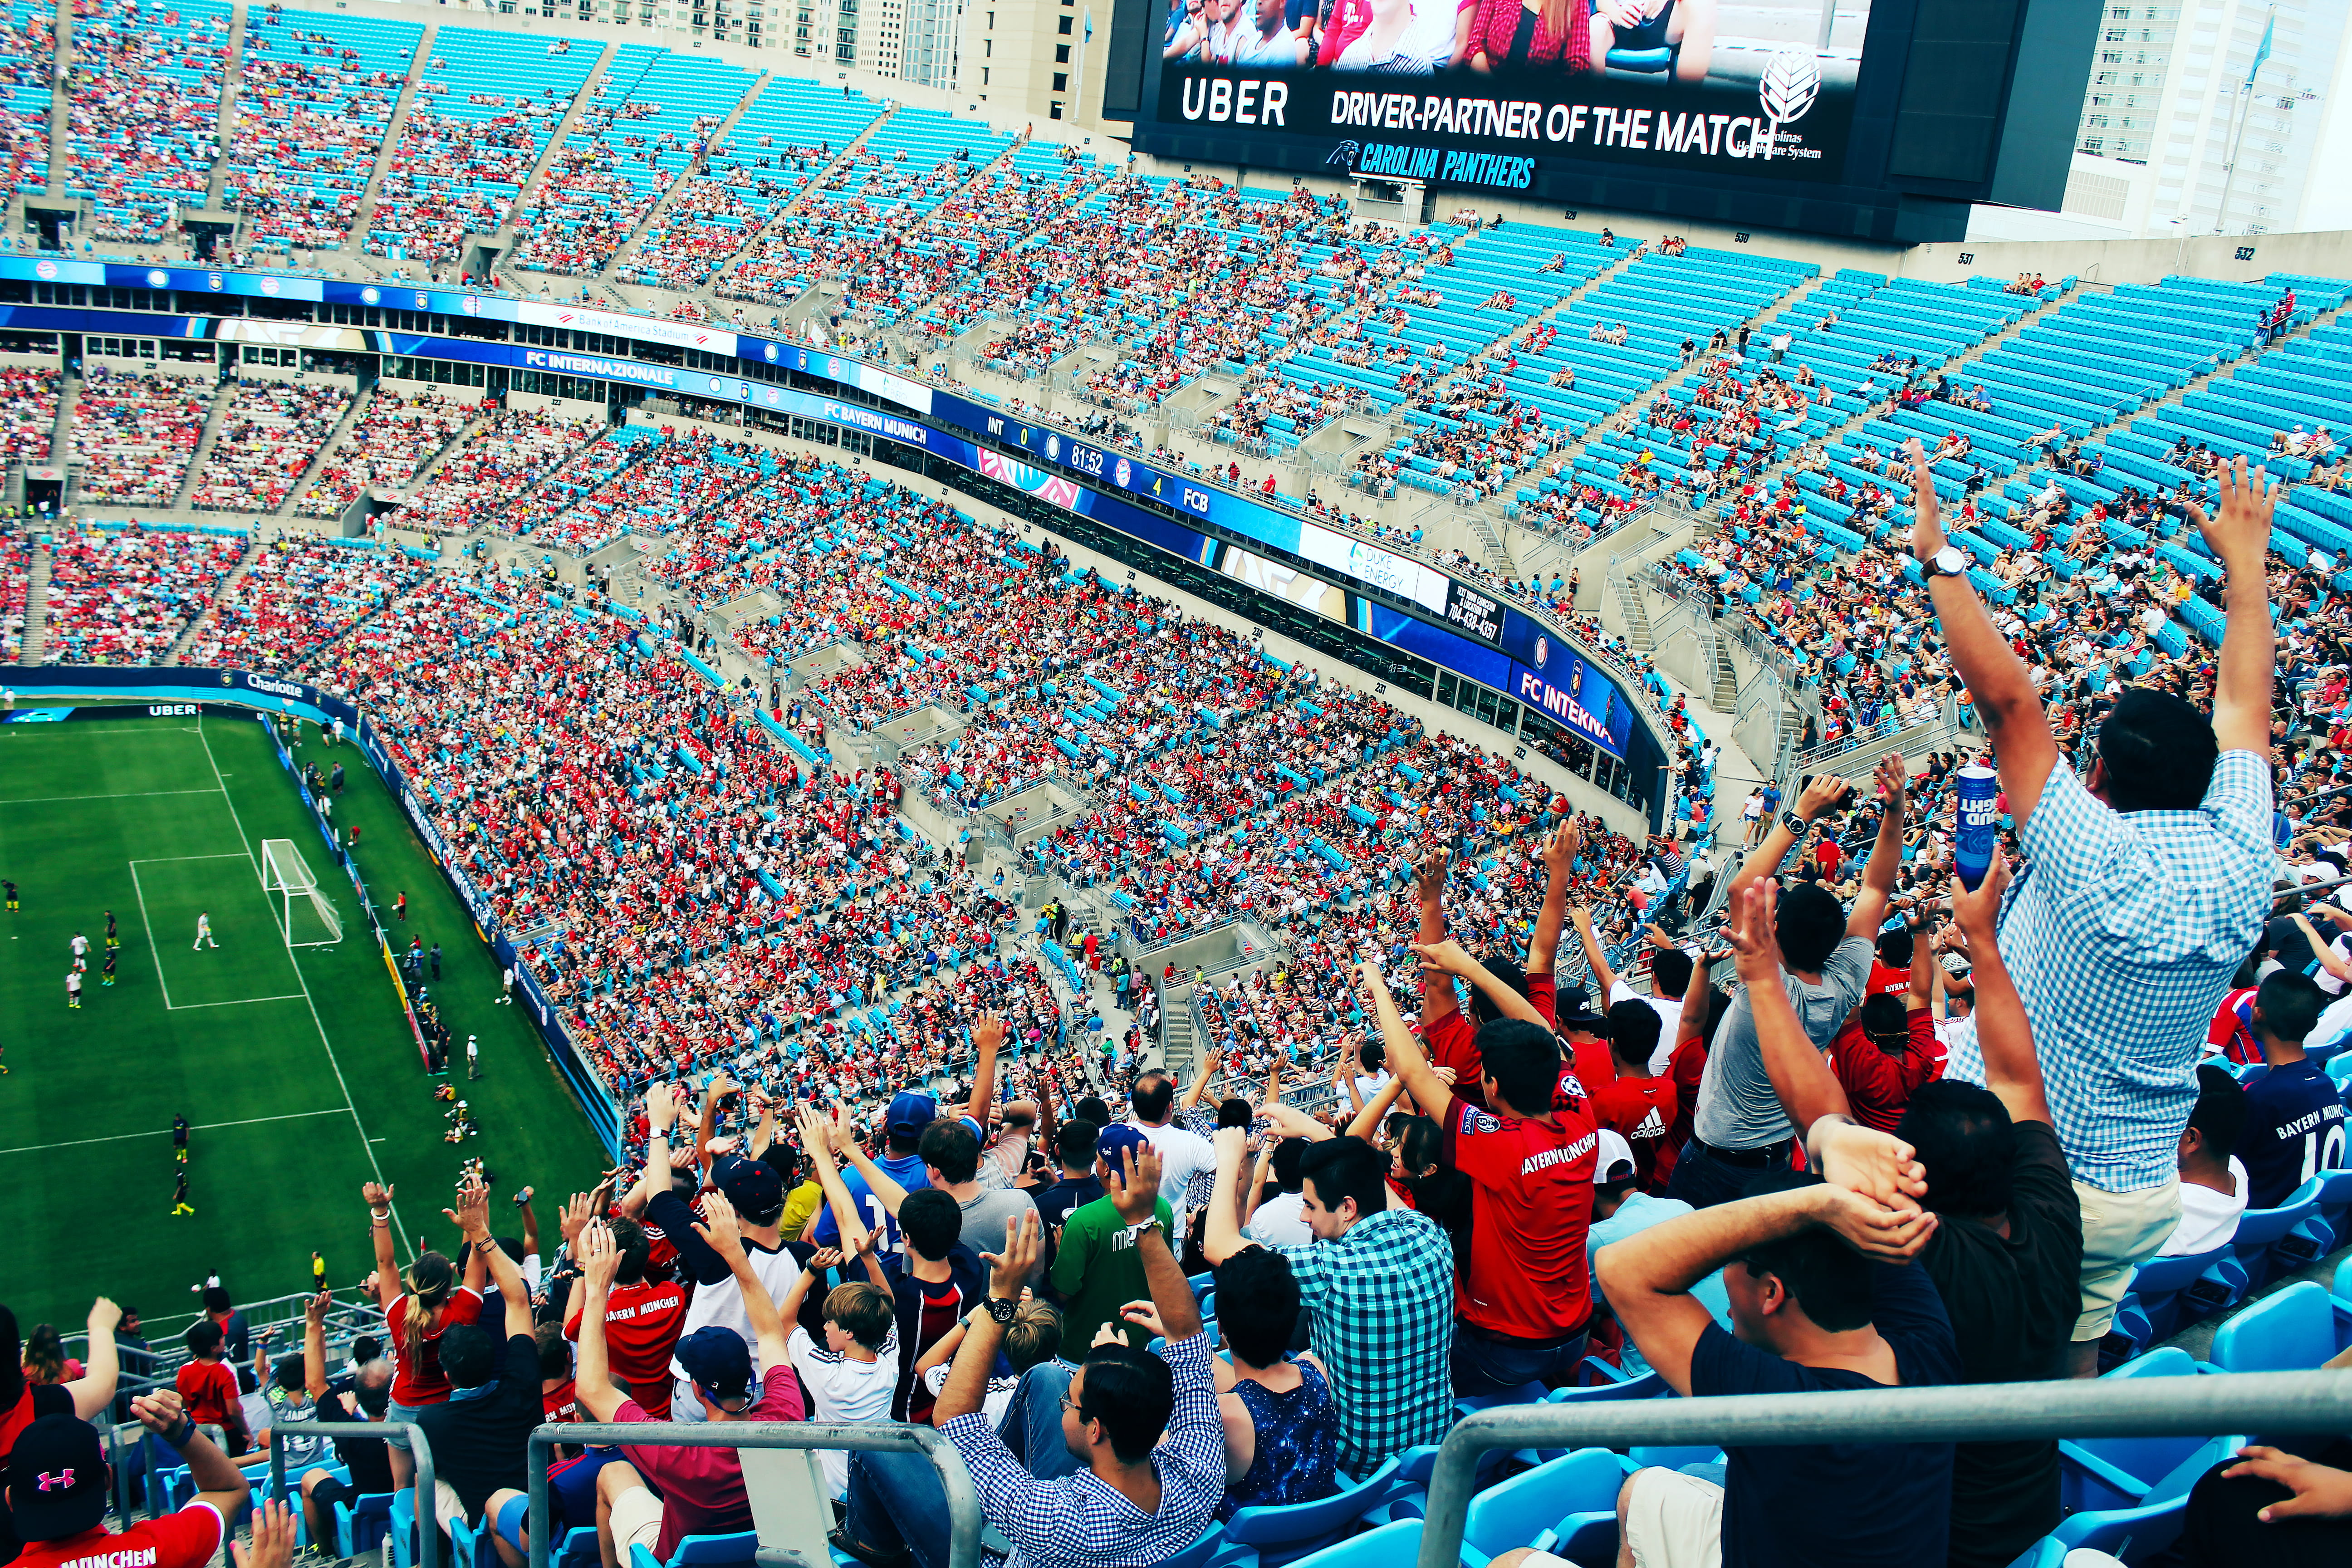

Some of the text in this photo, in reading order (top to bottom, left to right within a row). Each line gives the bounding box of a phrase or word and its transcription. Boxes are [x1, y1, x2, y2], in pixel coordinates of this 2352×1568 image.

[1182, 77, 1289, 127] UBER
[1331, 91, 1779, 160] DRIVER-PARTNER OF THE MATCH
[1759, 129, 1803, 143] Colinas
[1737, 140, 1822, 160] Hethare System
[1361, 143, 1535, 189] CAROLINA PANTHERS
[1735, 232, 1750, 243] 530
[1958, 253, 1974, 265] 531
[2234, 246, 2254, 261] 532
[579, 314, 689, 341] Bank of America Stadium
[526, 351, 673, 385] FC INTERNAZIONALE
[824, 402, 926, 444] FC BAYERN MUNICH
[988, 416, 1210, 513] INT 0 81:52 4 FCB
[1367, 549, 1392, 569] DUKE
[1364, 565, 1403, 591] ENERGY
[1456, 585, 1496, 612] TEXT YOUR CONCERN
[1463, 599, 1483, 616] LOCATION
[1481, 608, 1488, 618] TO
[1252, 627, 1263, 638] 230
[1448, 603, 1498, 640] 704-438-4357
[247, 674, 303, 698] Charlotte
[1374, 682, 1387, 695] 231
[1521, 671, 1542, 702] FC
[149, 704, 196, 716] UBER
[404, 789, 443, 861] INTERNATIONAL
[476, 903, 492, 929] CUP
[1631, 1125, 1665, 1140] adidas
[2276, 1110, 2320, 1140] BAYERN
[2301, 1125, 2346, 1186] 10
